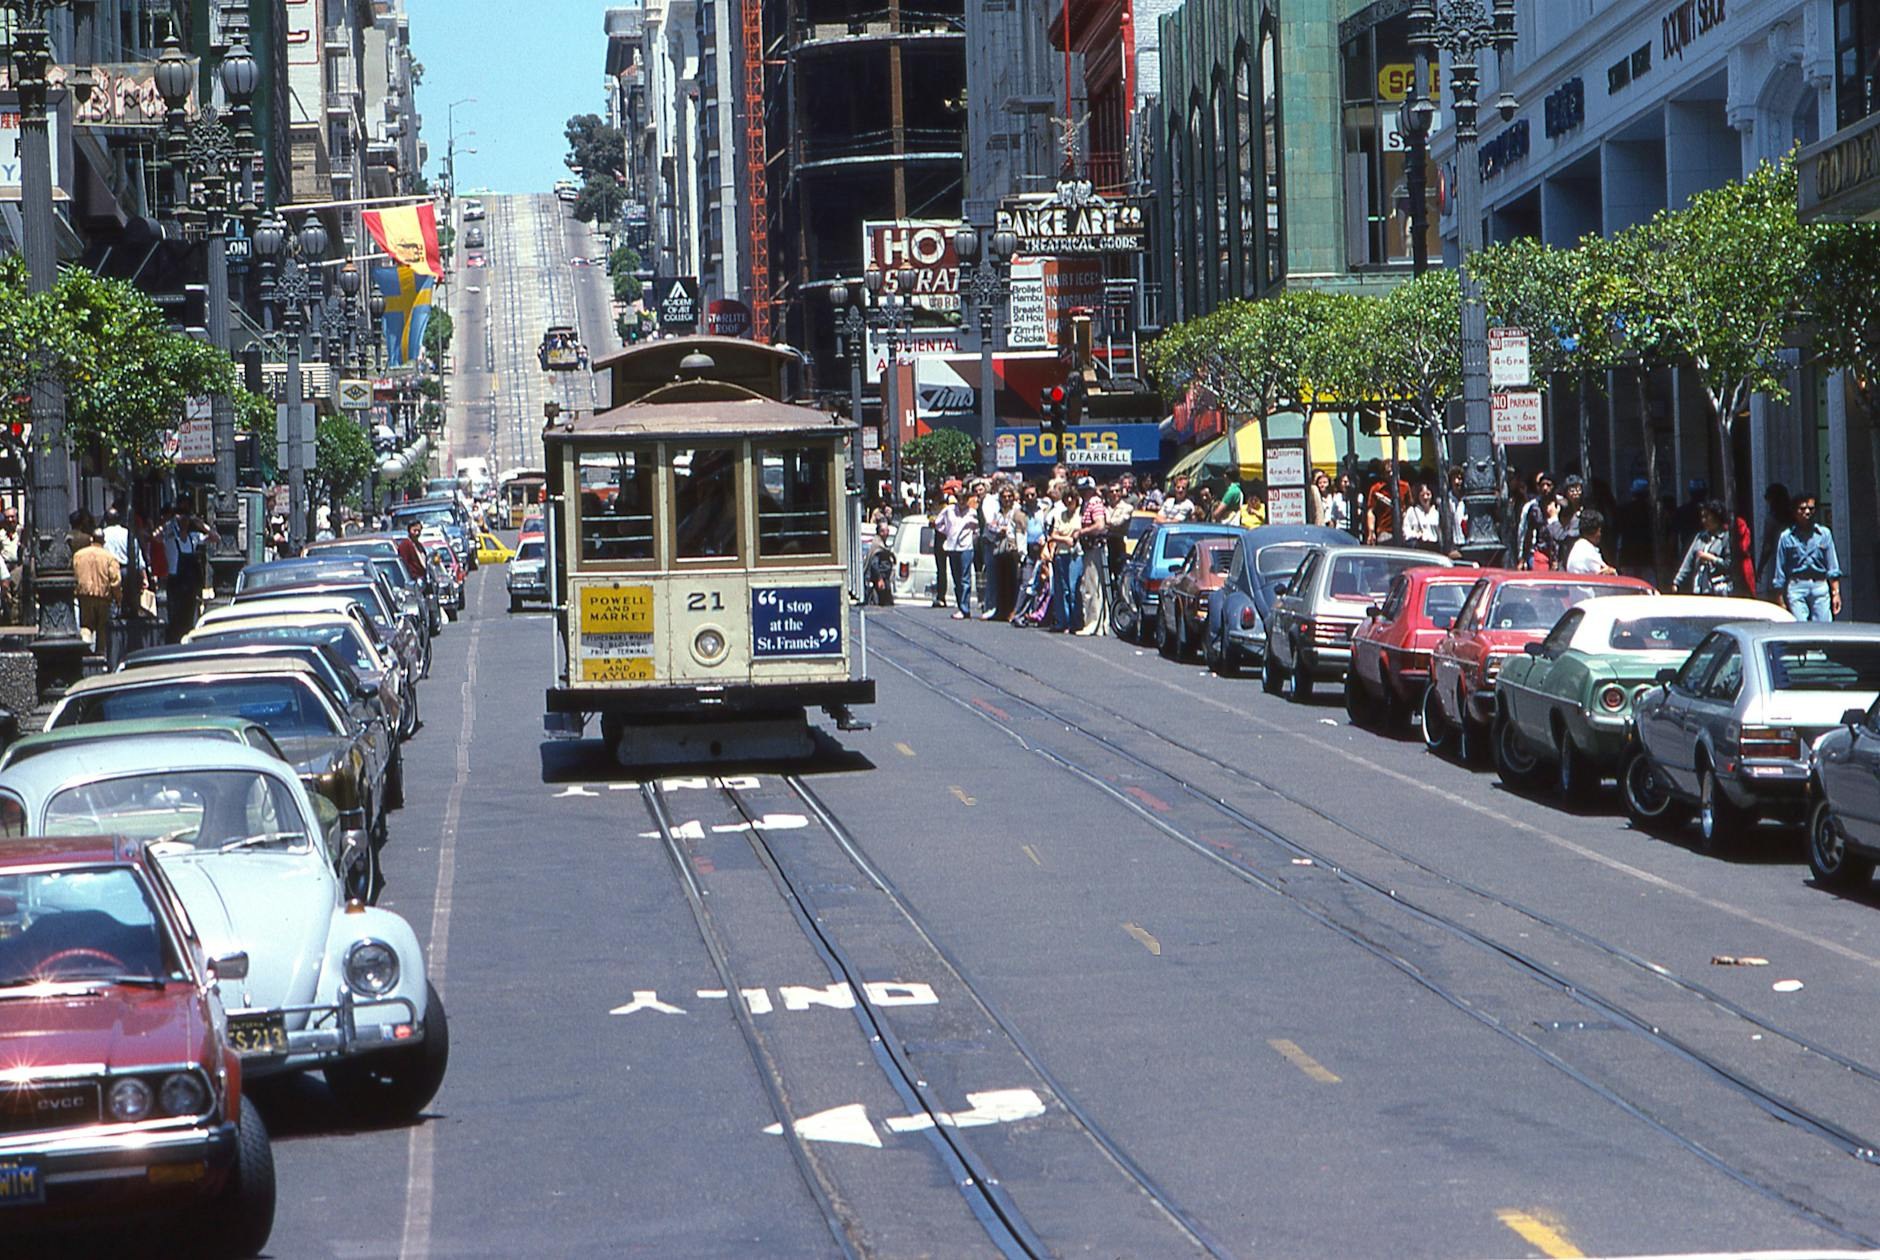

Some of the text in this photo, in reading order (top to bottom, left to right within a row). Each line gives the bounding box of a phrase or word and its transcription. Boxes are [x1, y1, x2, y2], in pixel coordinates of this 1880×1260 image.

[1076, 208, 1118, 235] ART
[1024, 236, 1138, 250] THEATRICAL GOODS
[1493, 395, 1538, 409] NO PARKING
[1516, 424, 1537, 432] THURS
[997, 432, 1118, 457] PORTS
[1070, 453, 1128, 462] O'FARRELL
[1268, 490, 1279, 500] NO
[590, 596, 646, 605] POWELL
[687, 592, 724, 611] 21
[786, 600, 812, 614] stop
[590, 612, 646, 620] MARKET
[770, 618, 804, 632] at the
[592, 672, 646, 680] TAYLOR
[609, 982, 939, 1015] ONLY
